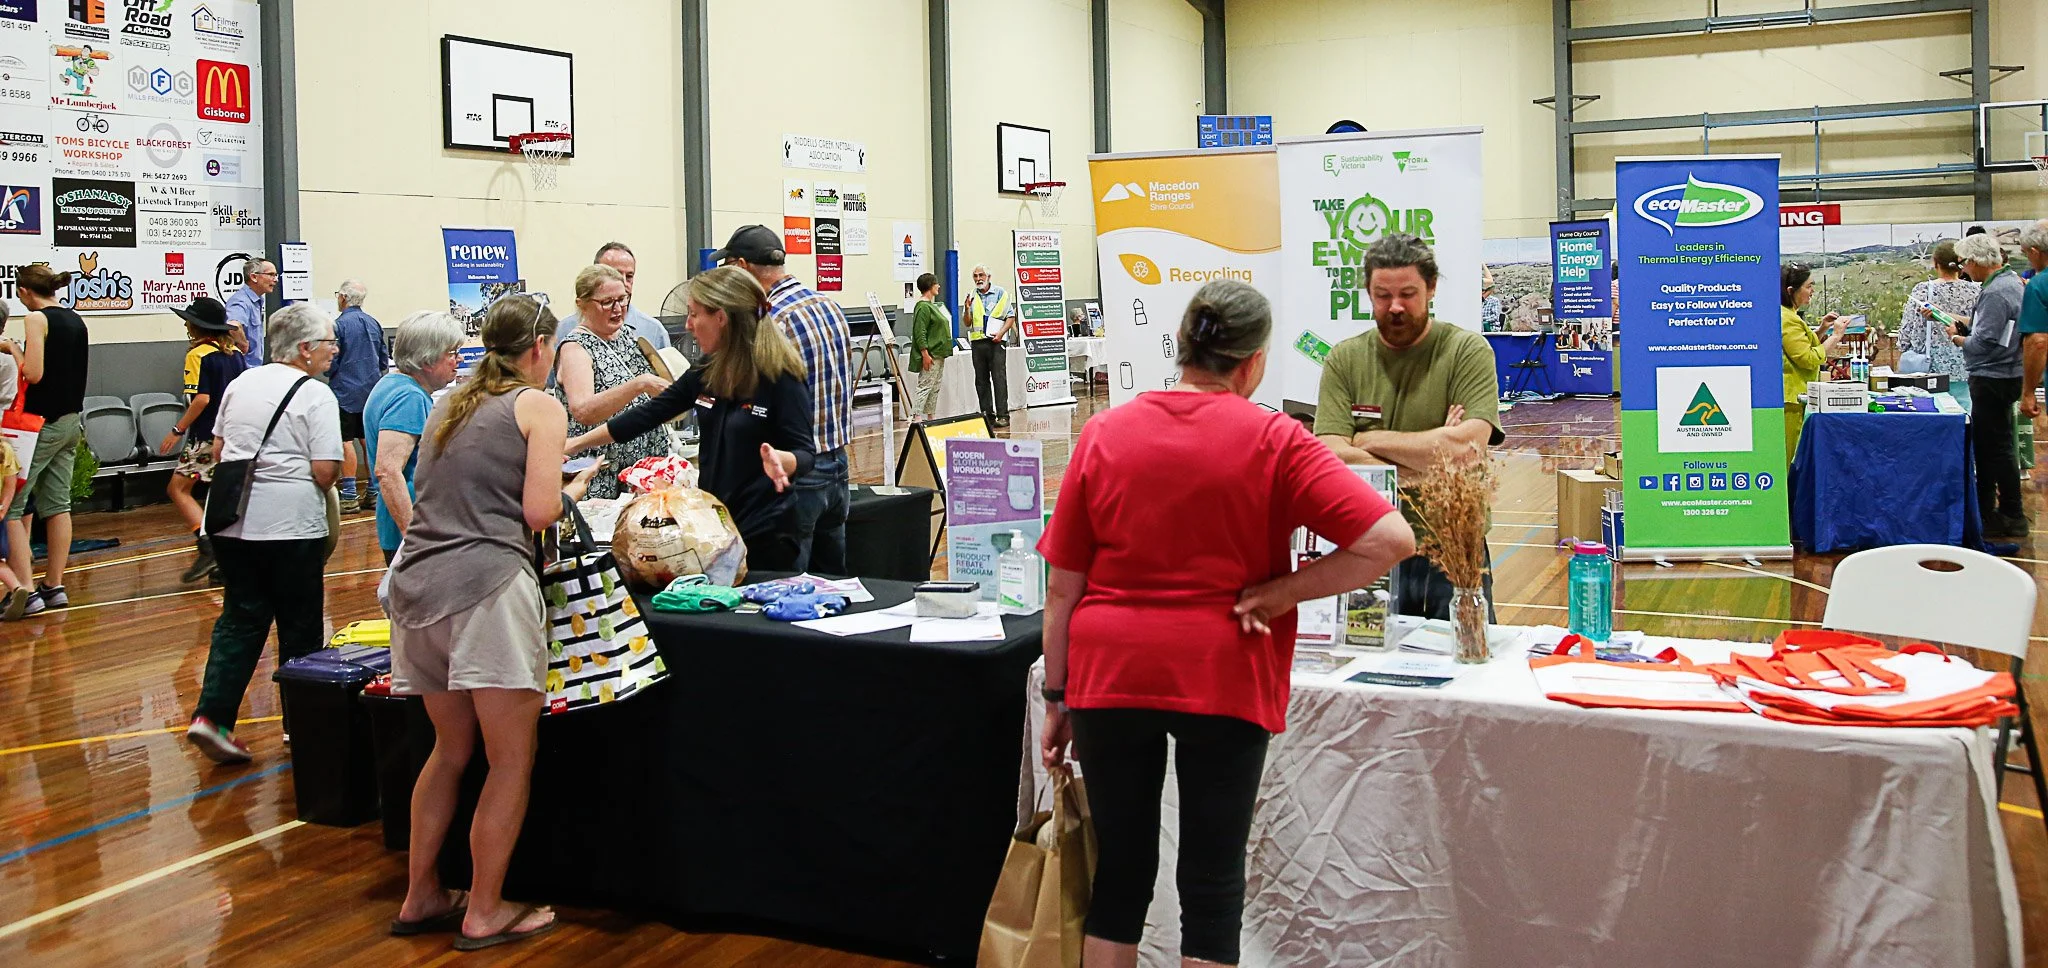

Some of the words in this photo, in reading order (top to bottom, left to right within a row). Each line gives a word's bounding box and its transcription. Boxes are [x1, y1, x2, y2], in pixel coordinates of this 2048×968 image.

[125, 7, 172, 27] Road
[133, 25, 169, 37] Outback
[217, 23, 242, 34] Finance
[9, 89, 31, 99] 8588
[51, 96, 64, 105] Mr
[66, 98, 117, 110] Lumberjack
[203, 106, 245, 119] Gisborne
[55, 136, 85, 147] TOMS
[88, 138, 130, 149] BICYCLE
[136, 138, 192, 149] BLACKFOREST
[819, 139, 835, 150] CREEK
[836, 141, 855, 152] NETBALL
[12, 152, 38, 162] 9966
[63, 149, 123, 161] WORKSHOP
[809, 151, 842, 162] ASSOCIATION
[1340, 154, 1384, 164] Sustainability
[1341, 162, 1366, 170] Victoria
[92, 169, 107, 177] 0400
[154, 172, 170, 180] 5427
[172, 173, 188, 181] 2693
[151, 186, 158, 194] W
[160, 187, 168, 195] &
[170, 187, 178, 195] M
[1149, 181, 1199, 191] Macedon
[56, 189, 132, 209] O'SHANASSY
[138, 196, 172, 206] Livestock
[173, 198, 208, 208] Transport
[1149, 192, 1191, 202] Ranges
[843, 201, 867, 211] MOTORS
[1313, 199, 1345, 211] TAKE
[1648, 198, 1746, 213] ecoMaster
[61, 206, 86, 214] MEATS
[94, 207, 127, 215] POULTRY
[149, 218, 168, 226] 0408
[184, 218, 198, 226] 903
[162, 229, 172, 237] 54
[173, 229, 187, 237] 293
[188, 230, 202, 238] 277
[1560, 241, 1593, 252] Home
[1675, 243, 1714, 252] Leaders
[1715, 242, 1725, 251] in
[450, 245, 509, 260] renew.
[1560, 254, 1599, 266] Energy
[1638, 255, 1679, 264] Thermal
[1680, 255, 1713, 265] Energy
[1715, 254, 1761, 264] Efficiency
[1170, 267, 1252, 285] Recycling
[1325, 267, 1340, 277] TO
[1560, 266, 1586, 278] Help
[59, 268, 132, 309] Josh's
[143, 280, 206, 293] Mary-Anne
[1331, 279, 1340, 289] A
[1661, 284, 1697, 295] Quality
[1698, 283, 1742, 292] Products
[141, 292, 187, 303] Thomas
[1651, 301, 1674, 312] Easy
[1674, 301, 1686, 310] to
[1686, 300, 1718, 309] Follow
[1719, 299, 1753, 309] Videos
[1668, 317, 1703, 327] Perfect
[1704, 317, 1717, 326] for
[1719, 317, 1735, 326] DIY
[1648, 343, 1758, 352] www.ecoMasterStore.com.au
[953, 451, 985, 459] MODERN
[979, 460, 1003, 468] NAPPY
[1683, 461, 1714, 469] Follow
[953, 466, 1001, 475] WORKSHOPS
[955, 553, 990, 561] PRODUCT
[956, 560, 983, 568] REBATE
[956, 567, 993, 576] PROGRAM
